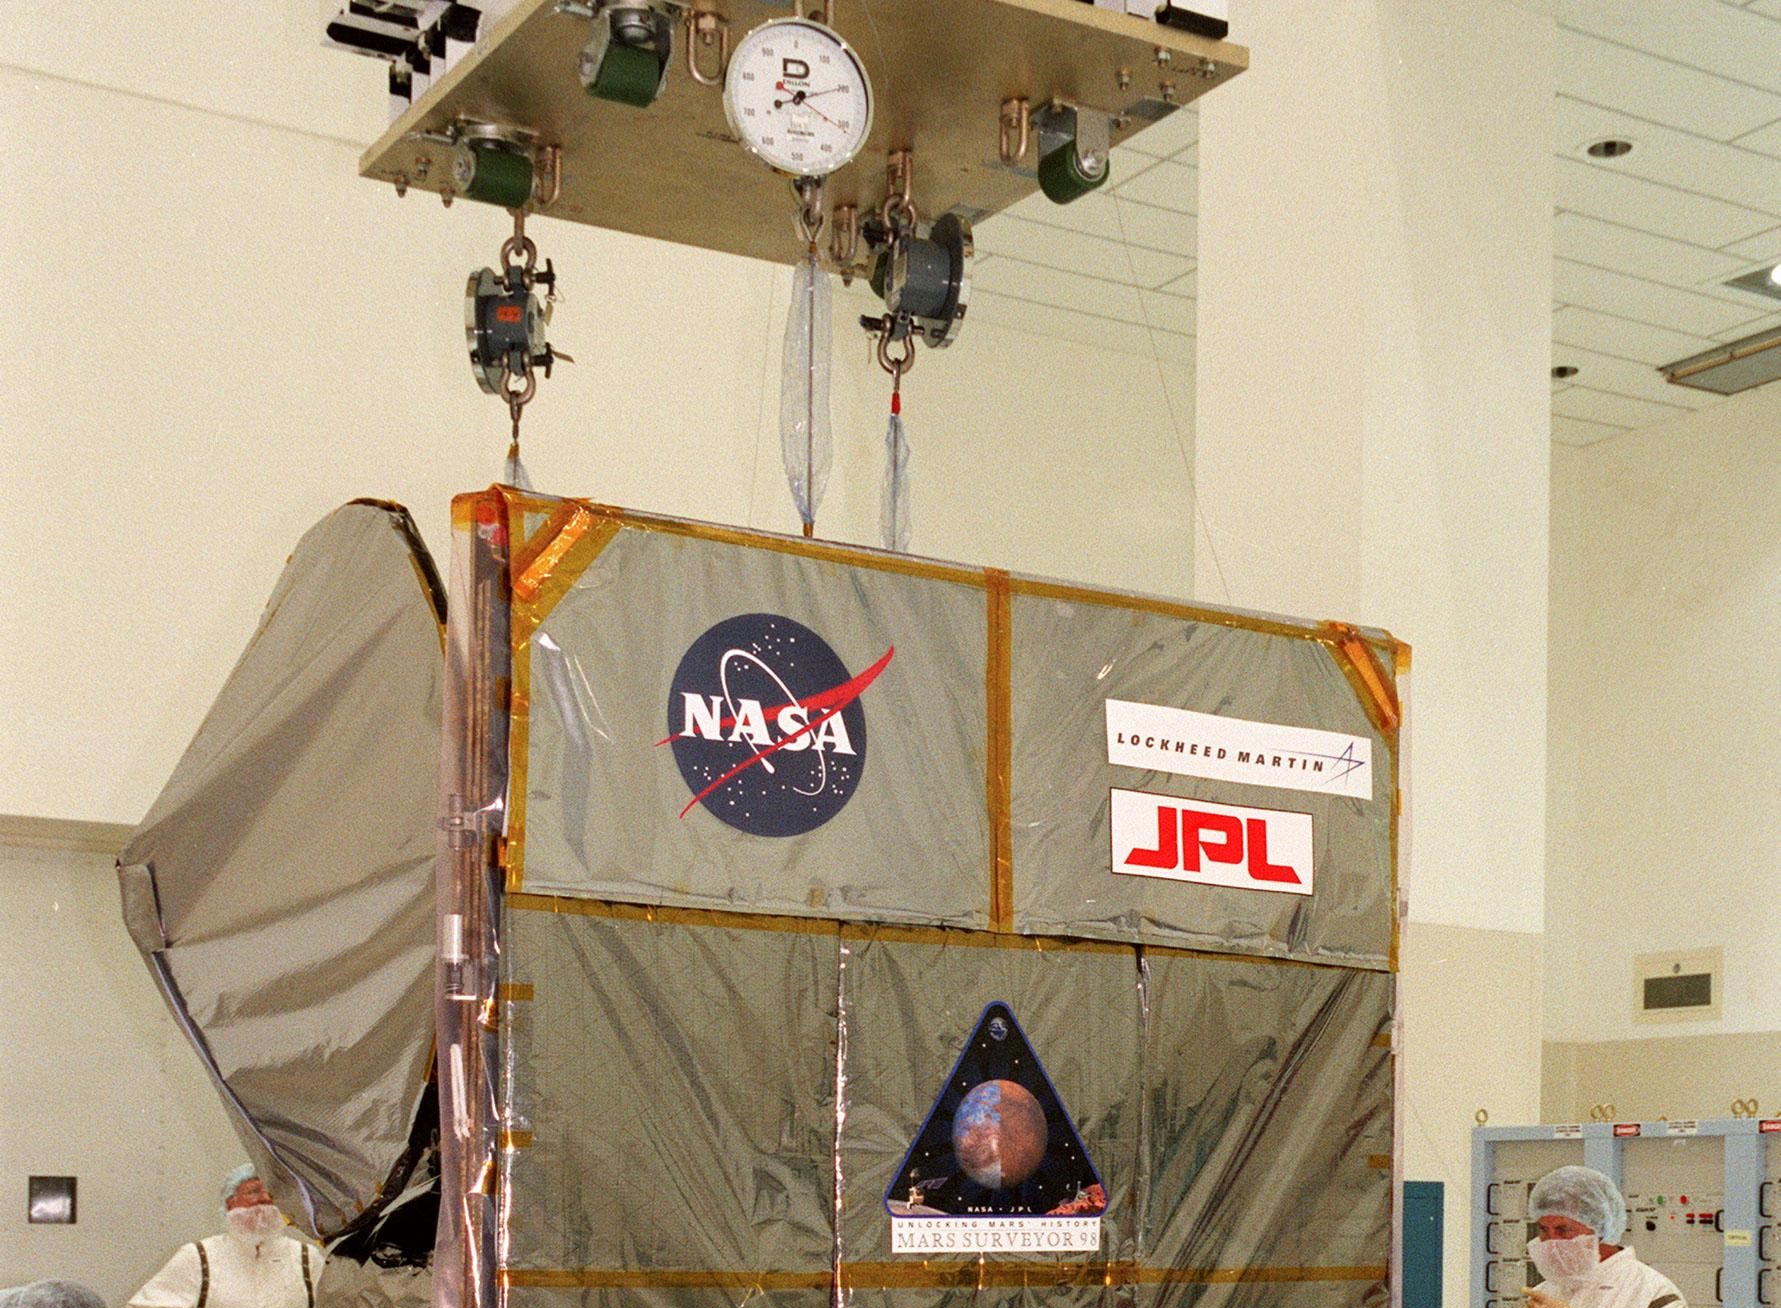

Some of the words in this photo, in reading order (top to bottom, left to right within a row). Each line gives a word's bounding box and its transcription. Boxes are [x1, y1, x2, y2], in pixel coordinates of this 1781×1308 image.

[783, 58, 810, 79] D
[819, 55, 830, 64] 100
[821, 144, 832, 153] 400
[679, 691, 858, 756] NASA
[1117, 732, 1227, 760] LOCKHEED
[1237, 751, 1324, 773] MARTIN
[1124, 805, 1302, 885] JPL
[1041, 1220, 1098, 1228] HISTORY
[898, 1233, 956, 1248] MARS
[962, 1232, 1073, 1248] SURVEYOR
[1080, 1231, 1097, 1246] 98
